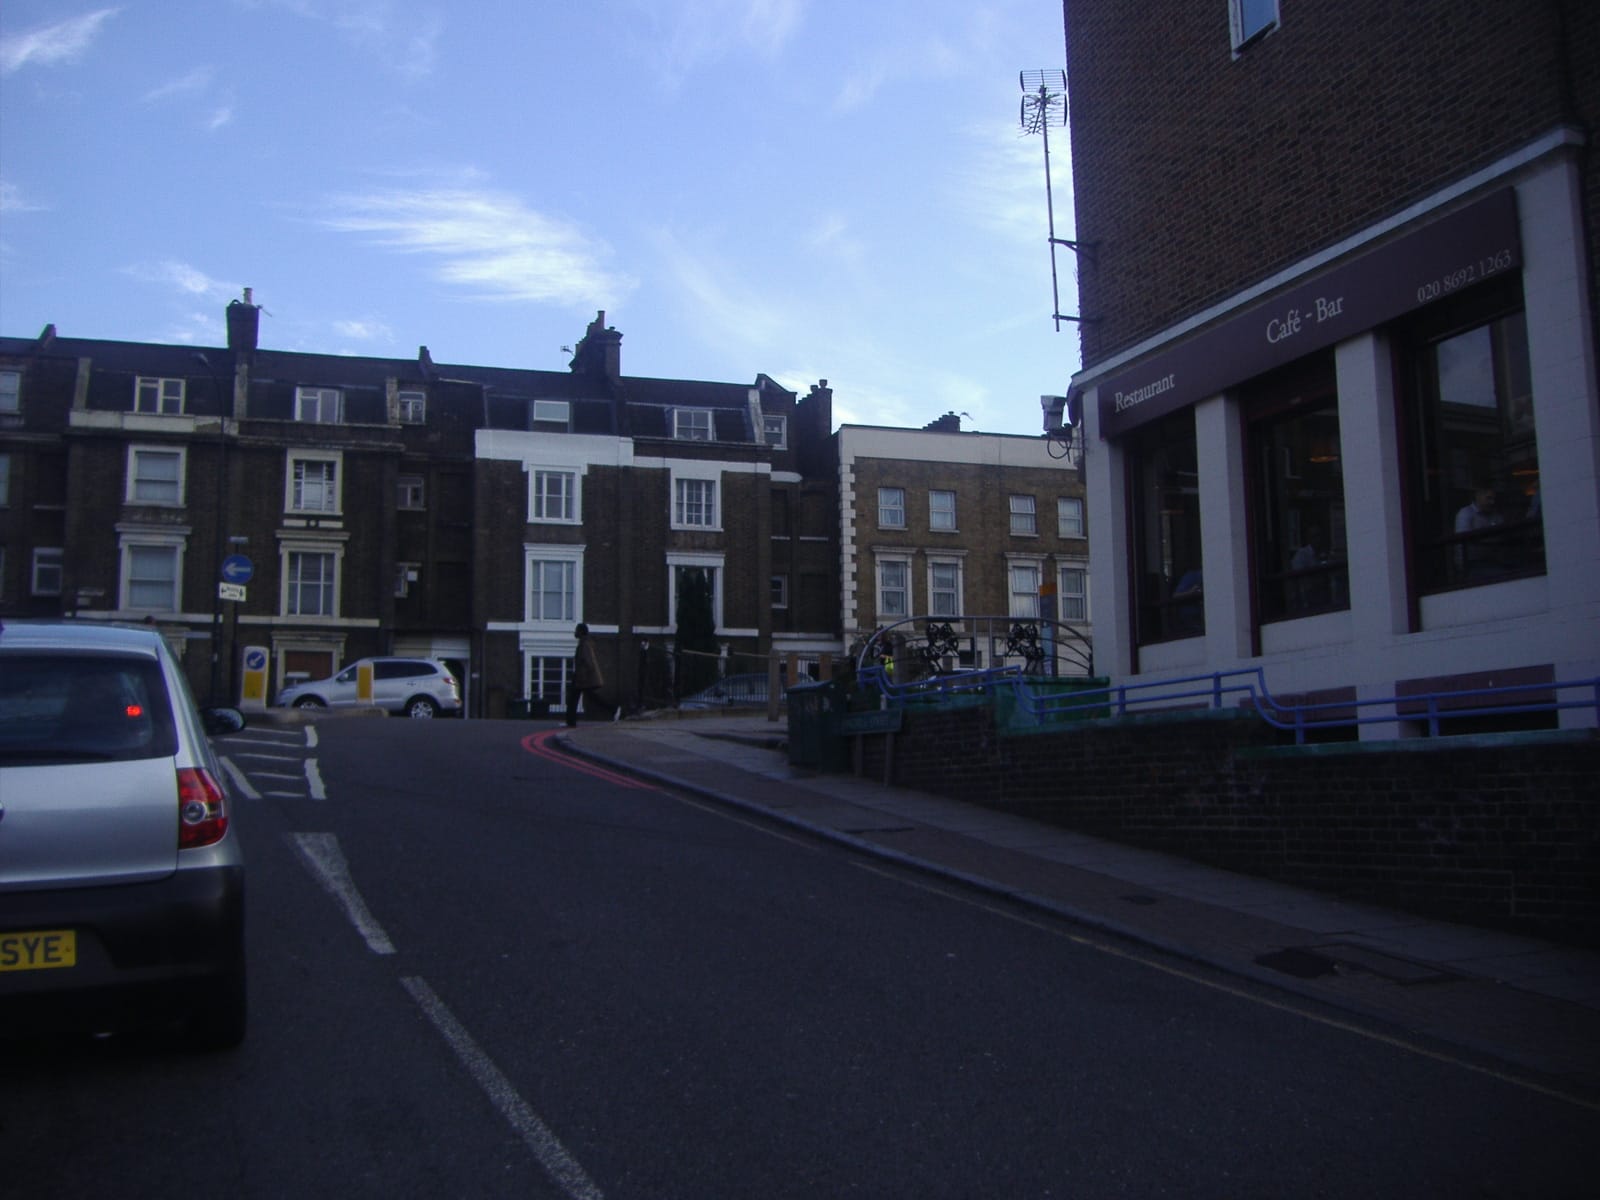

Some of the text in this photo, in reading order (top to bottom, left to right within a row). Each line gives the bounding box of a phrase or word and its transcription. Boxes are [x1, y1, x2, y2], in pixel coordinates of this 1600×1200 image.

[1417, 249, 1512, 302] 020 8692 1263
[1266, 310, 1301, 344] Café
[1316, 296, 1345, 323] Bar
[1114, 373, 1175, 413] Restaurant
[1, 936, 62, 966] SYE
